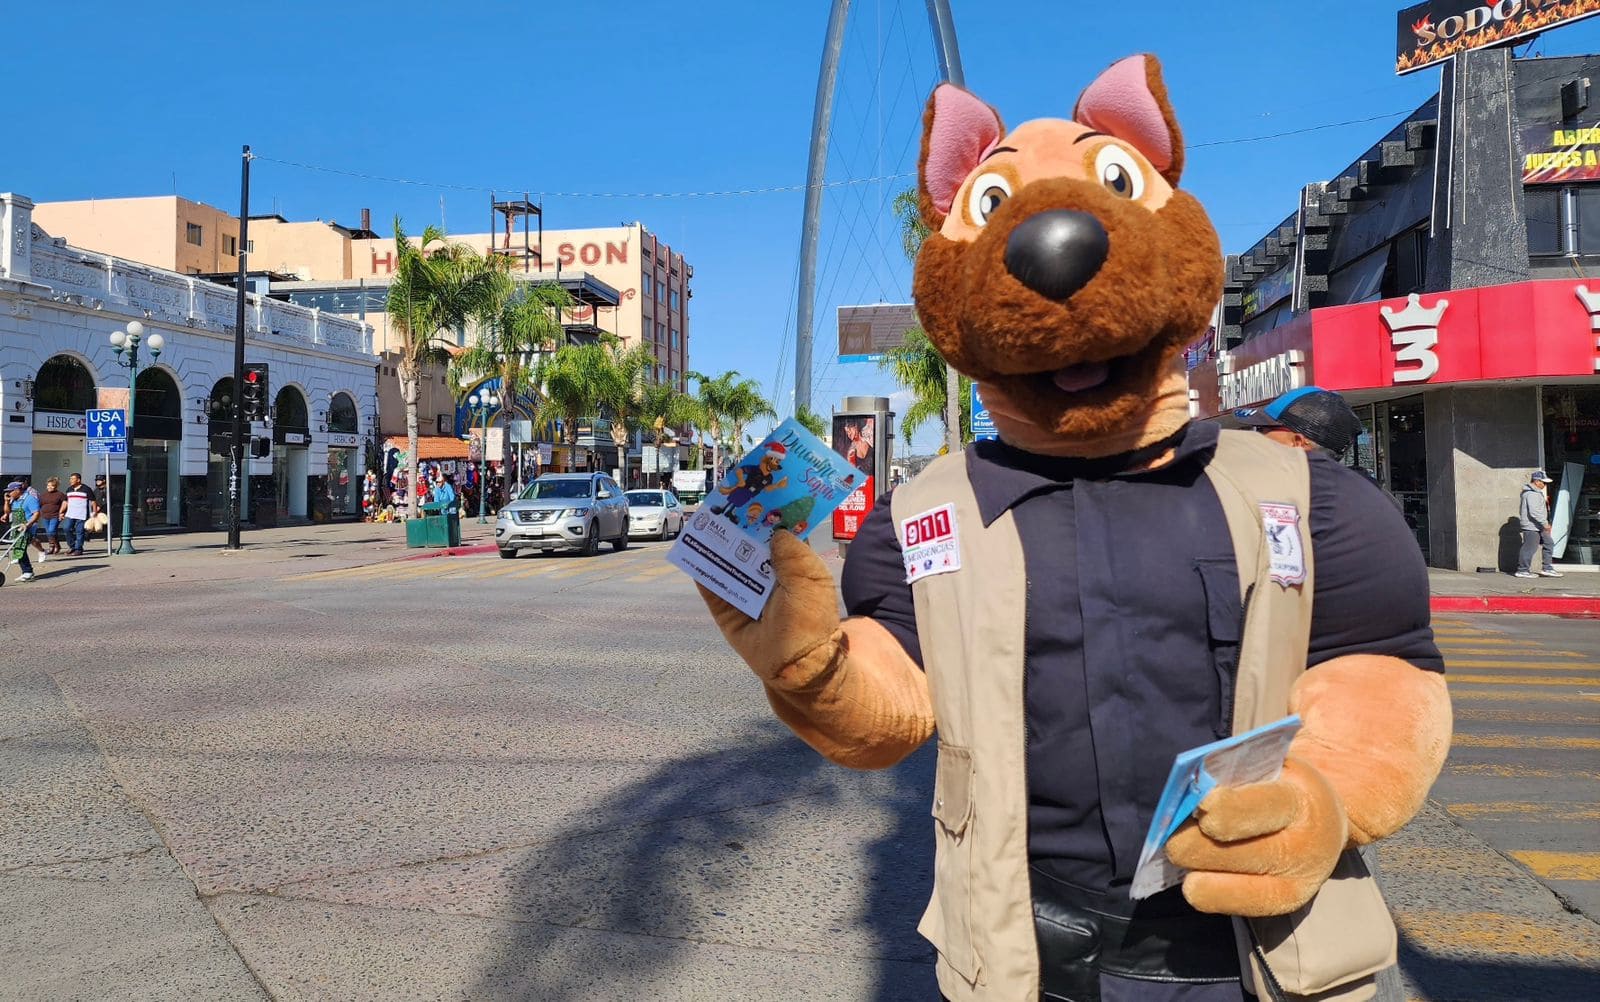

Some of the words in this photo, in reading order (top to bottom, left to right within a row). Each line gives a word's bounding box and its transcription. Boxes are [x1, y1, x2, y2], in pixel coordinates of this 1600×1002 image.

[1525, 151, 1582, 170] JUEVES
[486, 242, 628, 270] LSON
[1392, 327, 1440, 383] 3
[46, 415, 76, 429] HSBC
[90, 411, 122, 423] USA
[907, 513, 947, 545] 911
